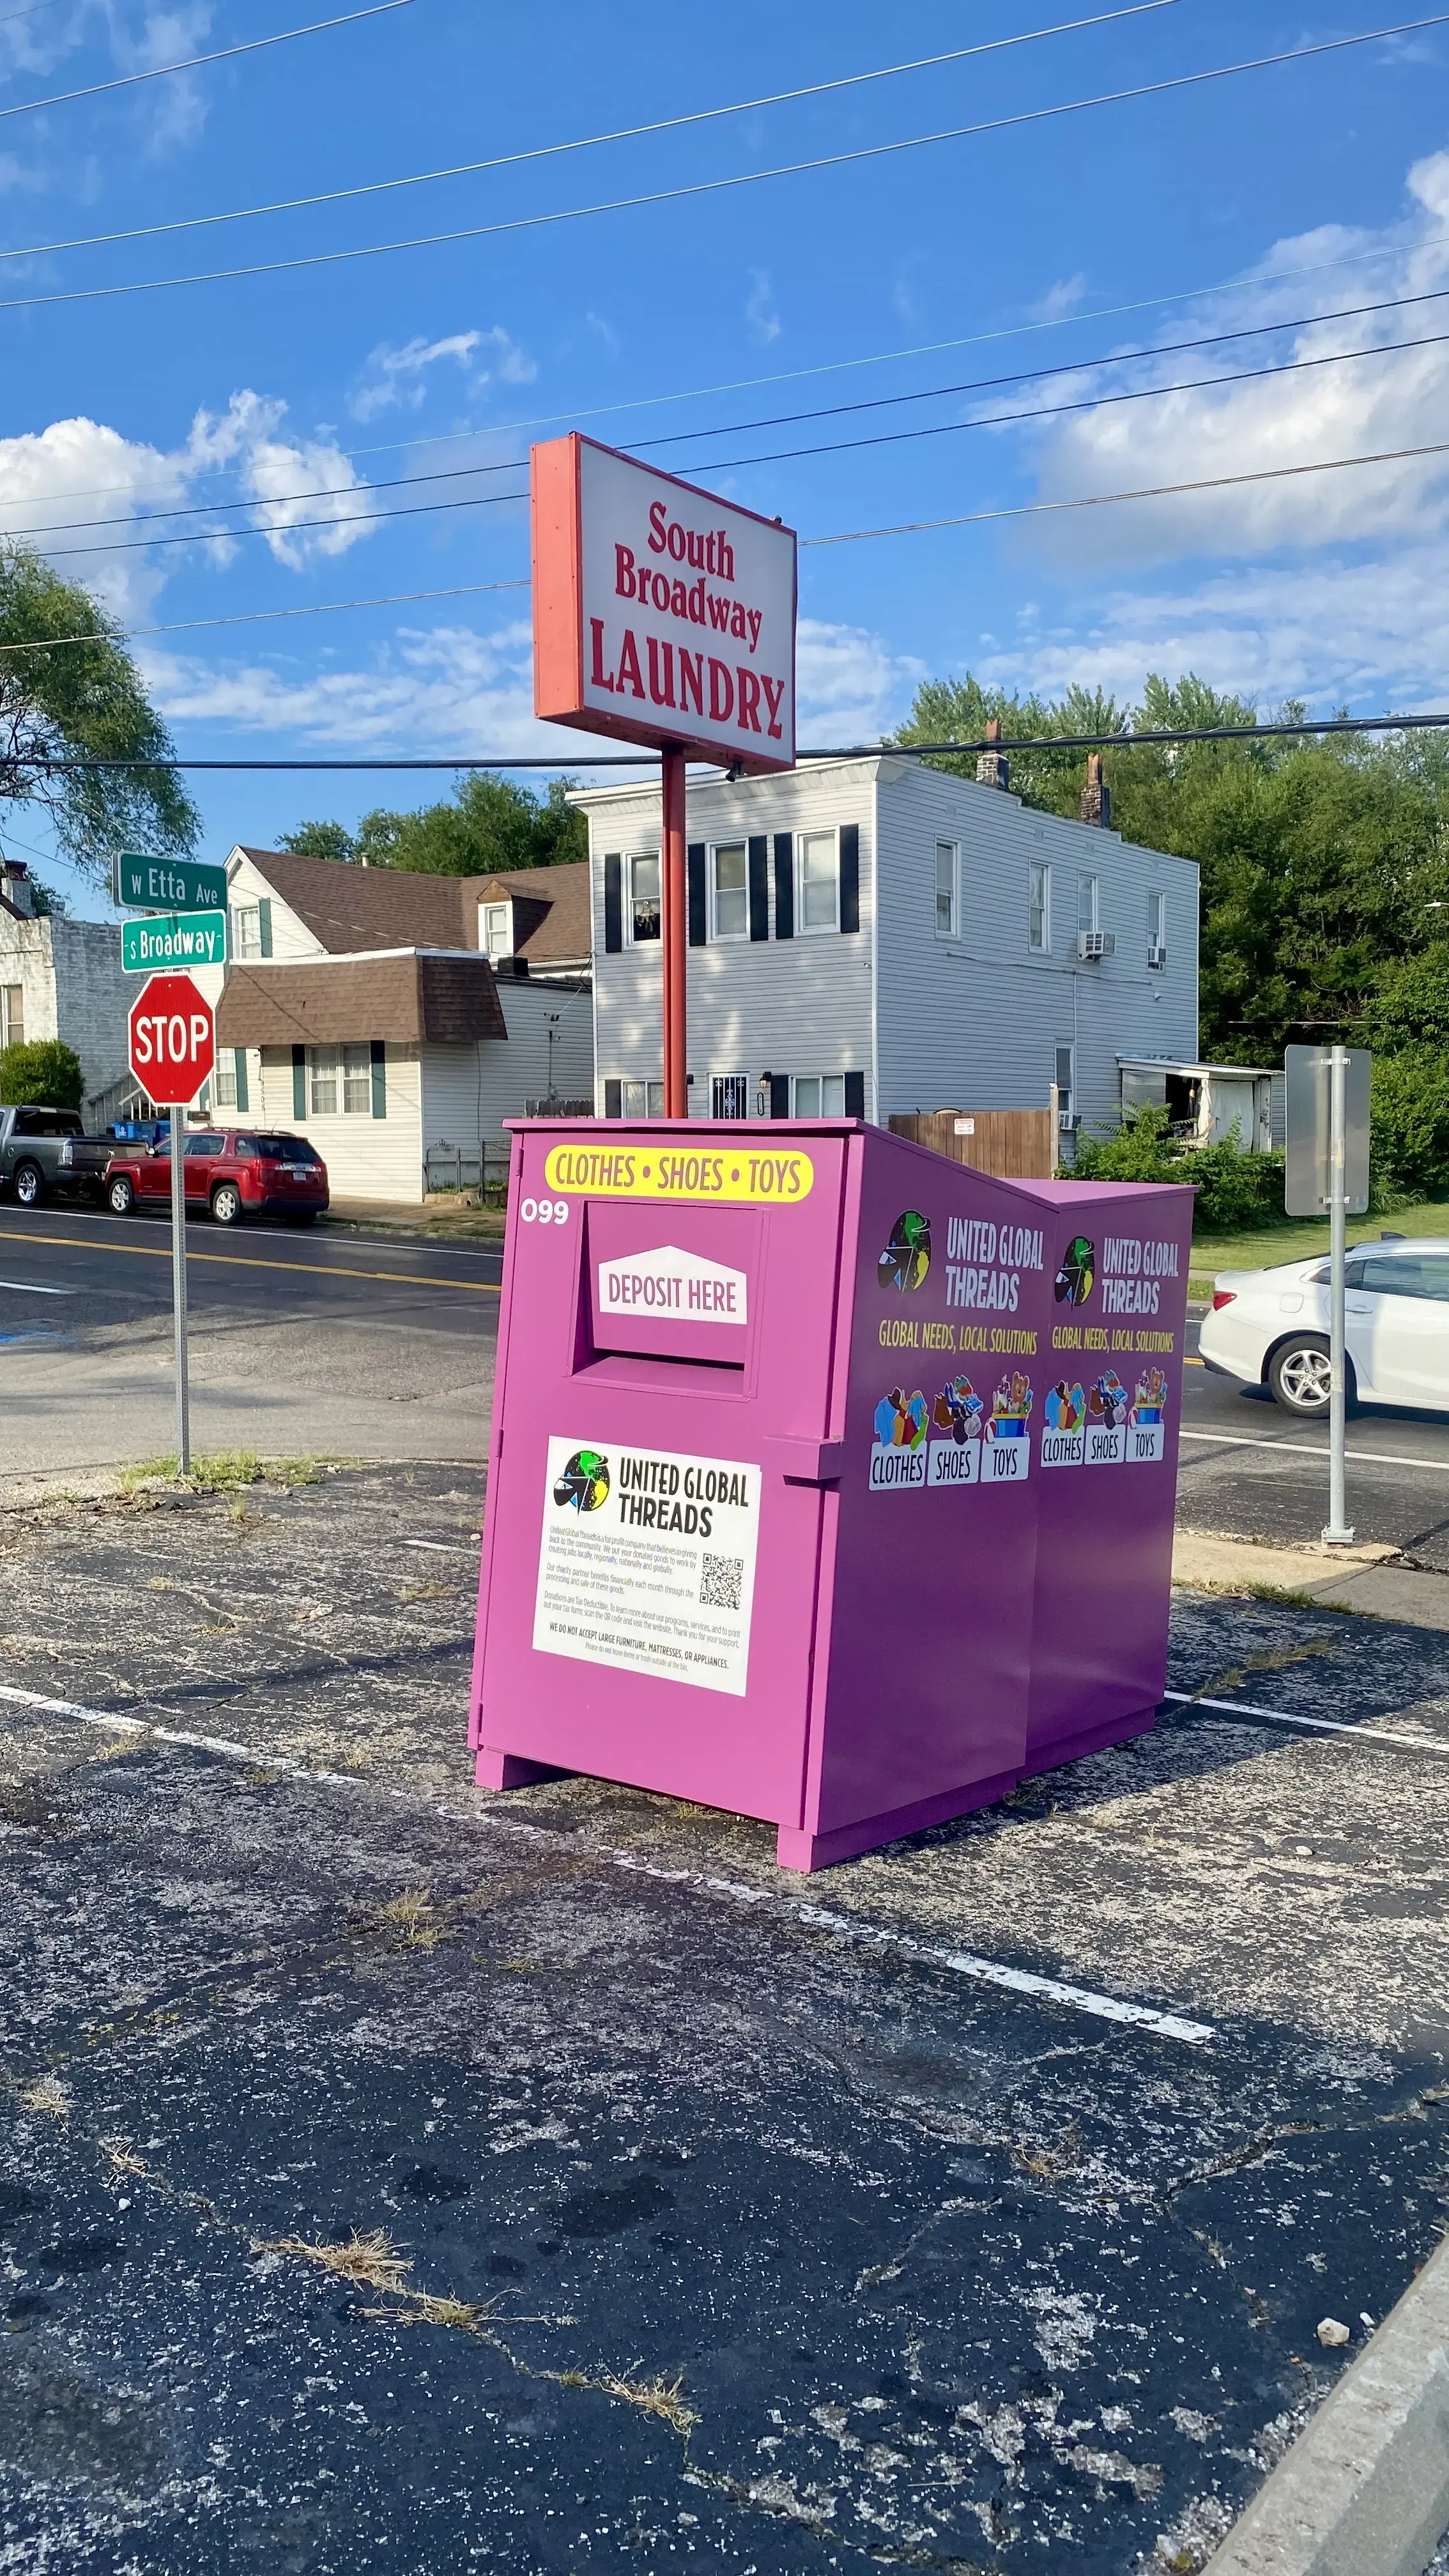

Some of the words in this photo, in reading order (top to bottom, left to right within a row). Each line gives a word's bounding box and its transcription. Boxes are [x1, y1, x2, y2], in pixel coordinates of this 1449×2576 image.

[647, 502, 735, 581] South
[615, 542, 762, 653] Broadway
[590, 617, 785, 739] LAUNDRY
[148, 868, 185, 901] Etta
[195, 884, 218, 905] Ave
[141, 927, 216, 962] Broadway
[135, 1015, 209, 1064] STOP
[555, 1153, 636, 1187] CLOTHES
[657, 1157, 723, 1191] SHOES
[748, 1159, 801, 1193] TOYS
[521, 1198, 569, 1225] 099
[947, 1216, 997, 1263] UNITED
[999, 1225, 1044, 1271] GLOBAL
[1103, 1237, 1141, 1275] UNITED
[1143, 1241, 1179, 1277] GLOBAL
[608, 1273, 682, 1308] DEPOSIT
[689, 1279, 737, 1312] HERE
[945, 1265, 1020, 1312] THREADS
[1101, 1278, 1160, 1315] THREADS
[878, 1319, 919, 1348] GLOBAL
[922, 1322, 956, 1354] NEEDS,
[959, 1325, 988, 1352] LOCAL
[990, 1327, 1038, 1356] SOLUTIONS
[1052, 1326, 1082, 1350] GLOBAL
[1085, 1326, 1110, 1354] NEEDS,
[1111, 1330, 1134, 1352] LOCAL
[1134, 1330, 1174, 1353] SOLUTIONS
[872, 1453, 924, 1484] CLOTHES
[935, 1450, 971, 1481] SHOES
[992, 1448, 1018, 1477] TOYS
[1043, 1436, 1082, 1462] CLOTHES
[1091, 1434, 1119, 1459] SHOES
[1135, 1433, 1155, 1457] TOYS
[619, 1457, 680, 1496] UNITED
[683, 1467, 749, 1508] GLOBAL
[618, 1493, 714, 1538] THREADS
[549, 1535, 560, 1544] back
[604, 1545, 611, 1553] We
[633, 1550, 653, 1561] donated
[654, 1555, 669, 1564] goods
[670, 1556, 675, 1565] to
[677, 1559, 689, 1567] work
[690, 1560, 696, 1570] by
[549, 1545, 567, 1556] creating
[567, 1548, 577, 1557] jobs
[578, 1549, 594, 1560] locally,
[619, 1558, 642, 1569] nationally
[550, 1526, 565, 1535] United
[565, 1528, 579, 1538] Global
[580, 1530, 597, 1541] Threads
[611, 1537, 625, 1546] profit
[625, 1540, 645, 1551] company
[647, 1543, 657, 1552] that
[657, 1544, 676, 1555] believes
[682, 1549, 697, 1560] giving
[546, 1574, 570, 1585] processing
[580, 1579, 590, 1588] sale
[596, 1582, 609, 1591] these
[547, 1563, 556, 1571] Our
[556, 1565, 572, 1575] charity
[572, 1569, 590, 1578] partner
[590, 1570, 610, 1582] benefits
[611, 1574, 634, 1588] financially
[635, 1581, 647, 1589] each
[648, 1583, 664, 1592] month
[665, 1585, 684, 1597] through
[686, 1589, 694, 1598] the
[544, 1590, 567, 1602] Donations
[610, 1603, 615, 1613] To
[616, 1605, 628, 1614] learn
[628, 1609, 641, 1618] more
[641, 1611, 656, 1620] about
[712, 1626, 722, 1634] and
[722, 1627, 728, 1636] to
[728, 1629, 740, 1638] print
[595, 1611, 604, 1620] the
[604, 1612, 611, 1621] QR
[611, 1615, 623, 1623] code
[633, 1620, 643, 1628] visit
[549, 1622, 558, 1632] WE
[559, 1624, 567, 1634] DO
[567, 1625, 578, 1636] NOT
[579, 1629, 597, 1640] ACCEPT
[599, 1632, 615, 1644] LARGE
[617, 1636, 647, 1652] FURNITURE,
[648, 1643, 683, 1660] MATTRESSES,
[684, 1651, 693, 1661] OR
[694, 1653, 729, 1669] APPLIANCES.
